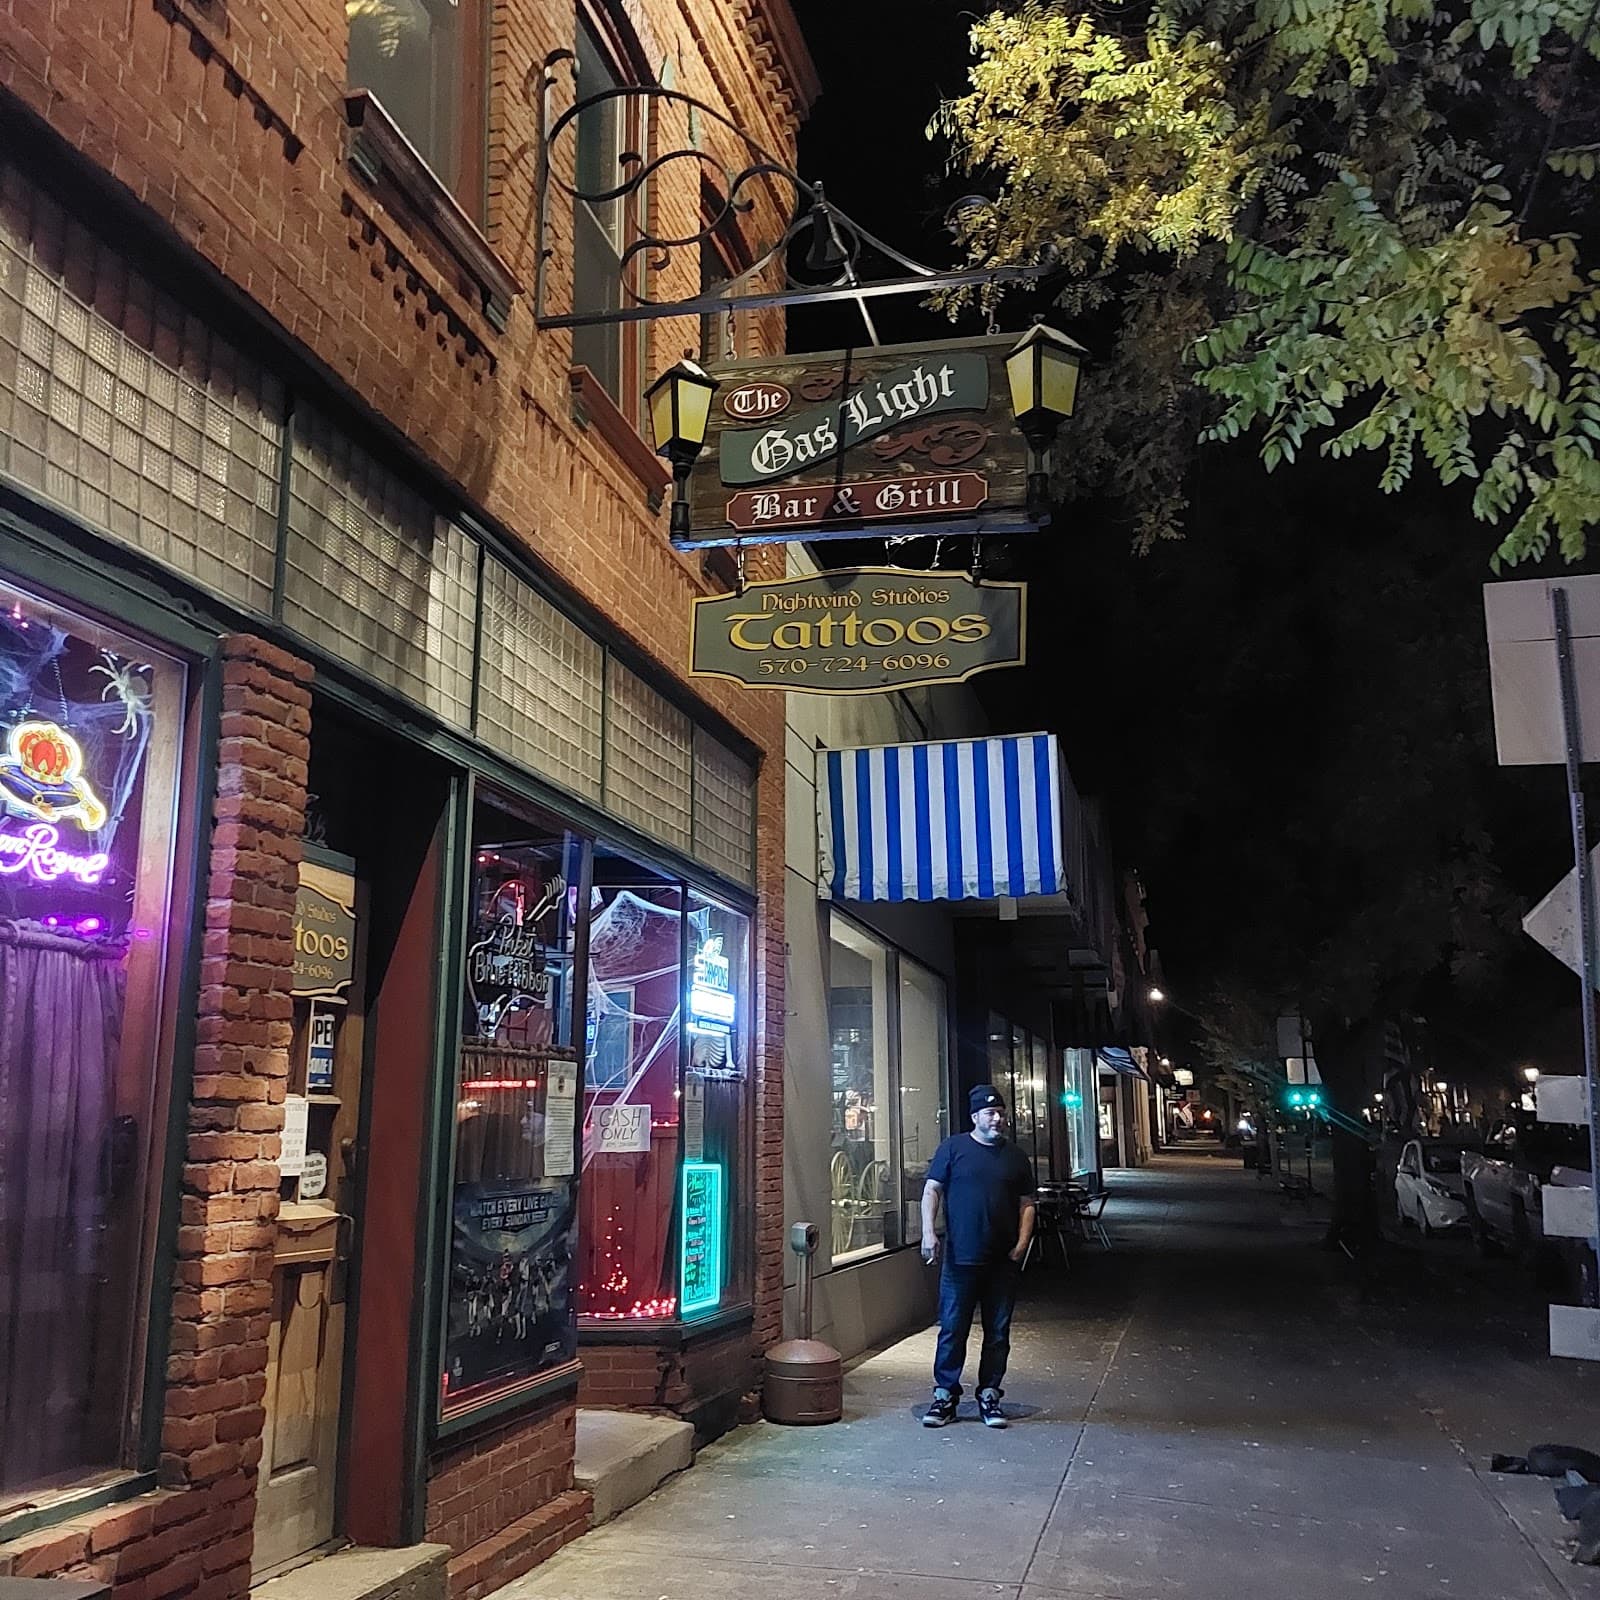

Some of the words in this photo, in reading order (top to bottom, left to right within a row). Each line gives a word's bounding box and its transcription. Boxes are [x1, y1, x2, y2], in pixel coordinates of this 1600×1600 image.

[731, 389, 783, 415] The
[751, 417, 838, 474] Gas
[839, 364, 957, 435] Light
[751, 493, 817, 524] Bar
[832, 487, 861, 514] &
[876, 479, 961, 511] Grill
[761, 590, 862, 614] Nightwind
[871, 586, 950, 606] Studios
[724, 611, 991, 651] Tattoos
[758, 653, 951, 675] 570-724-6096
[293, 920, 348, 961] toos
[599, 1108, 642, 1127] CASH
[601, 1127, 638, 1140] ONLY
[497, 1198, 523, 1214] EVERY
[523, 1195, 539, 1210] LIVE
